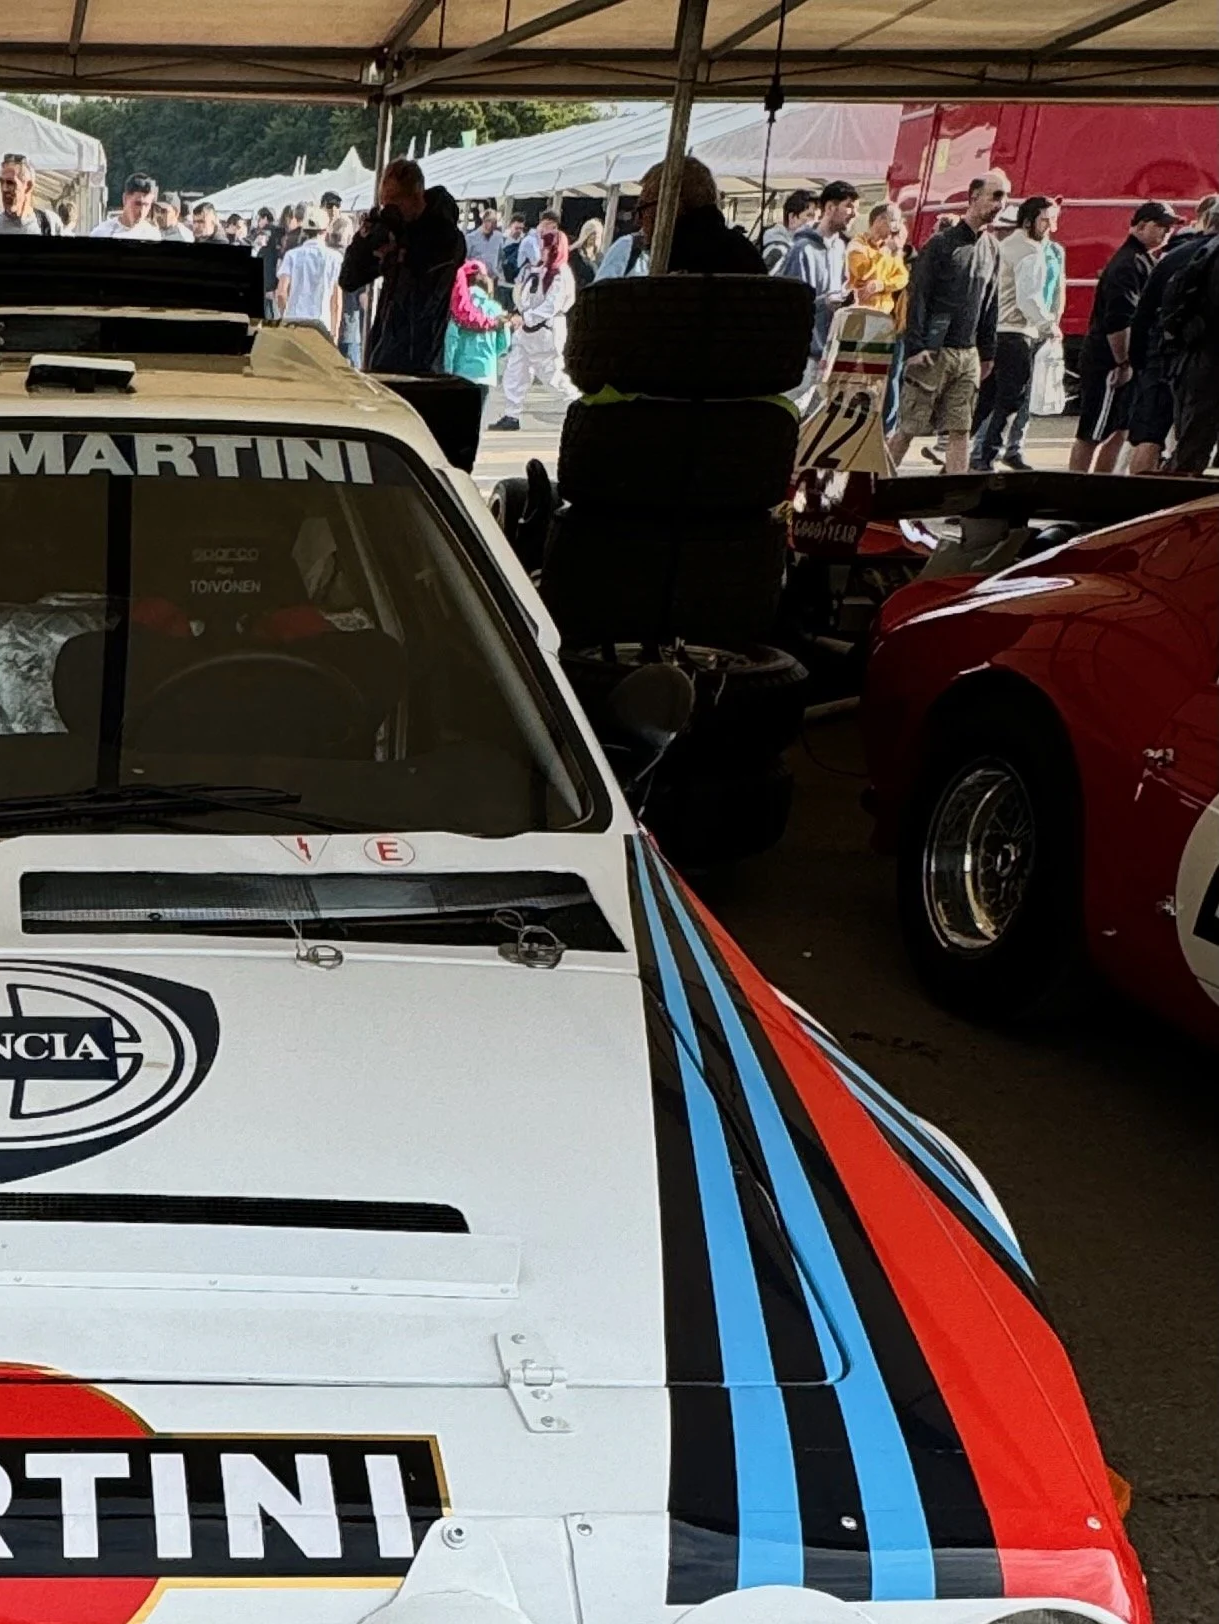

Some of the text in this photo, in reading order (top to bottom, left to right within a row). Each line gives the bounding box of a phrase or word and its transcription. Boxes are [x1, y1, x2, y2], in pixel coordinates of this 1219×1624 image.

[798, 390, 871, 467] 12
[190, 579, 262, 593] TOIVONEN
[376, 841, 403, 861] E
